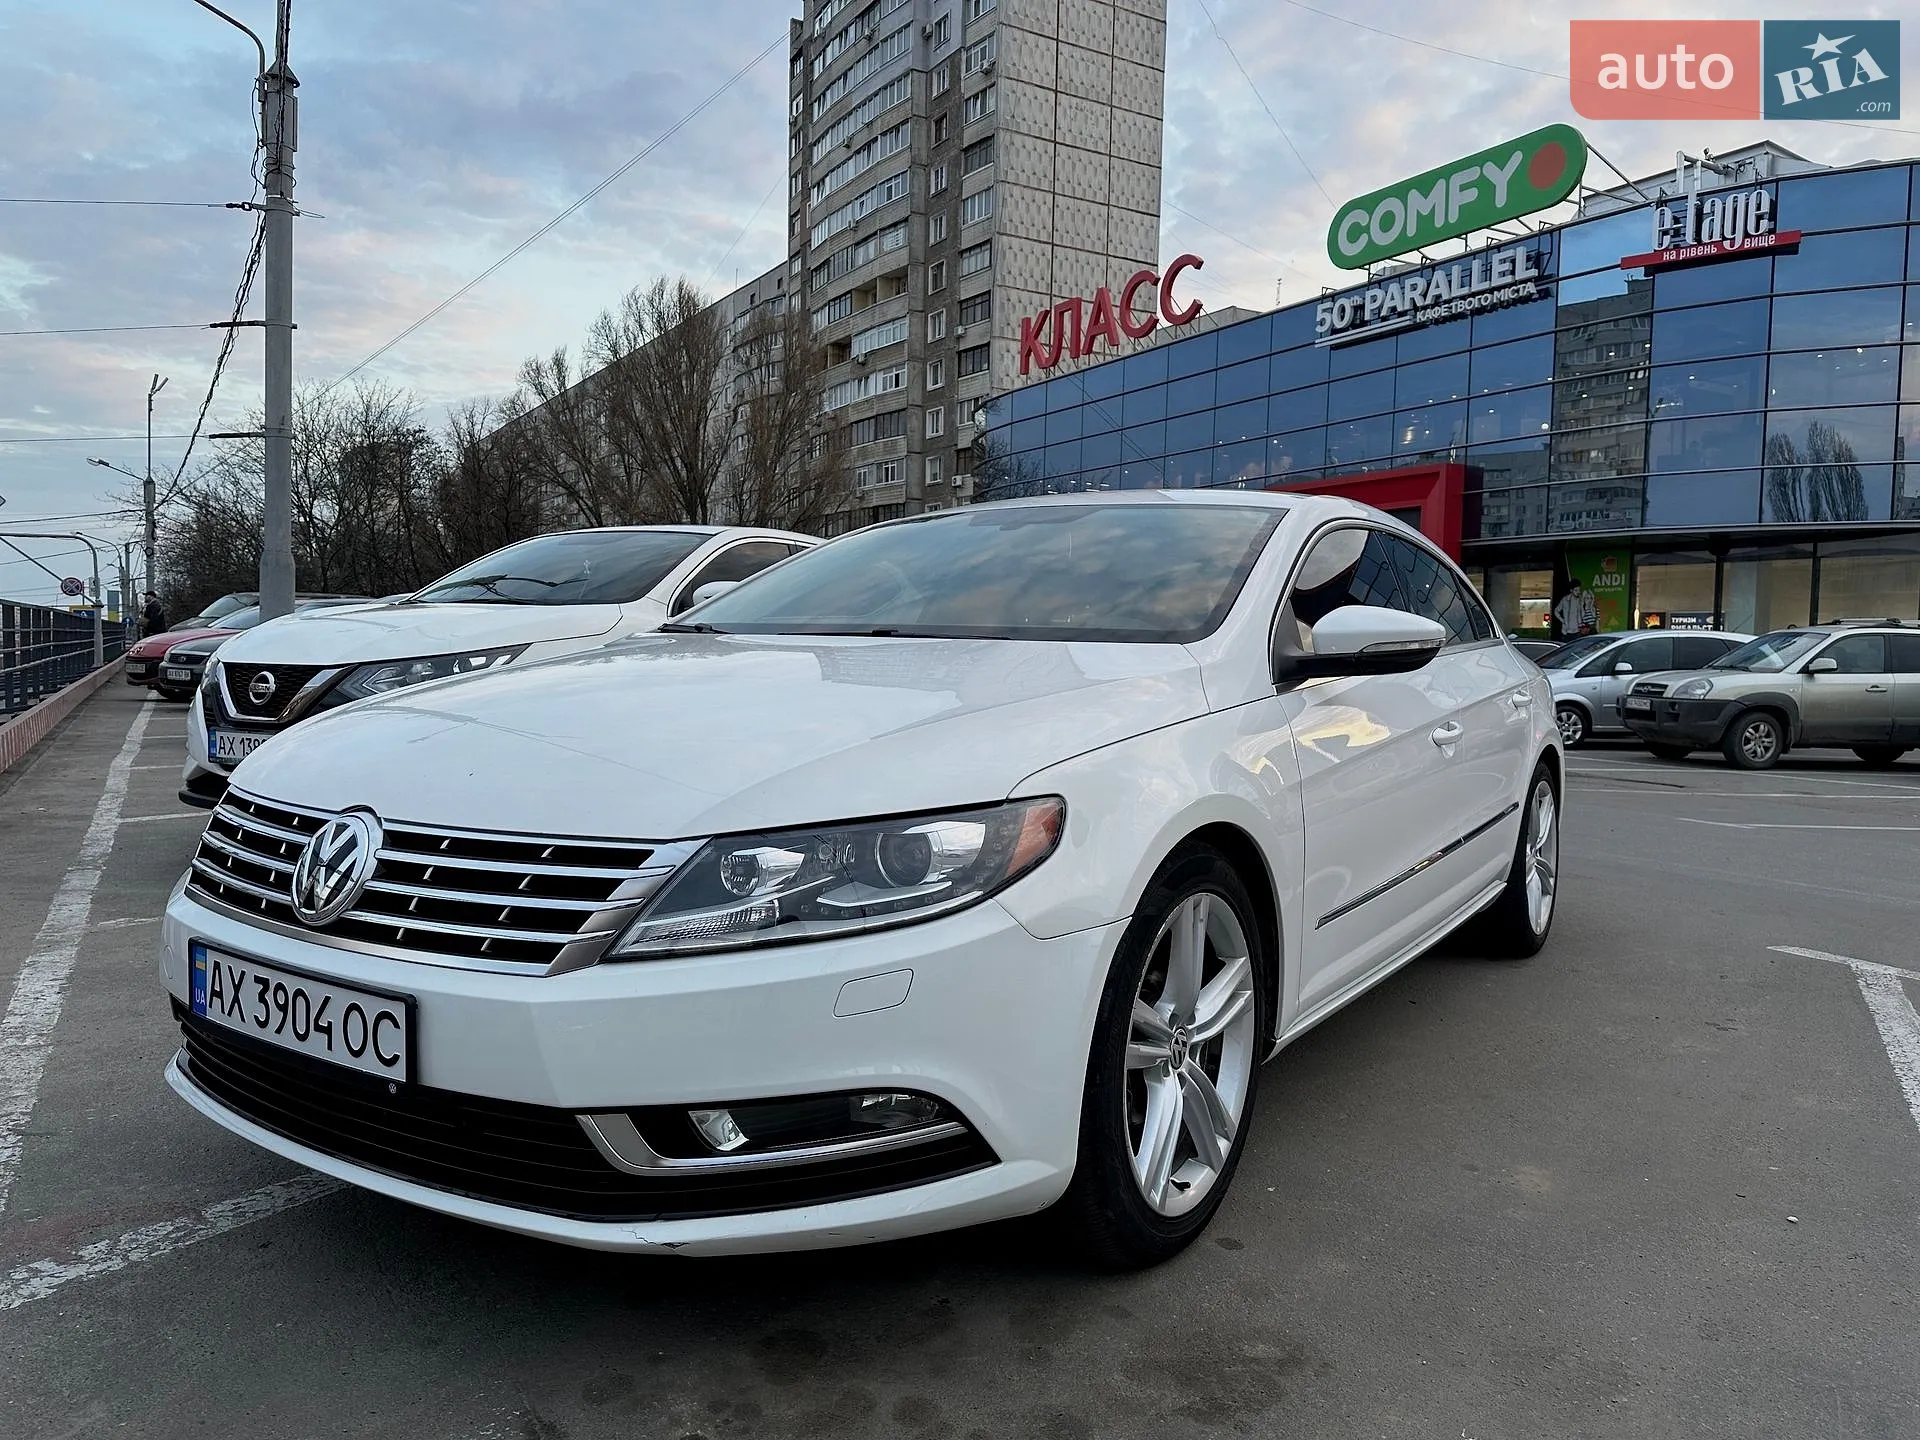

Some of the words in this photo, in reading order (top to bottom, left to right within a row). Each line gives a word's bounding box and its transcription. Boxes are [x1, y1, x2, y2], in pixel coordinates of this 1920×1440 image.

[1337, 150, 1523, 256] COMFY
[1663, 249, 1676, 261] на
[1680, 244, 1717, 261] рівень
[1744, 233, 1776, 249] вище
[1364, 246, 1538, 321] PARALLEL
[1416, 304, 1449, 323] КАФЕ
[1450, 293, 1493, 314] ТВОГО
[1493, 281, 1537, 303] МІСТА
[1019, 253, 1204, 375] КЛАСС
[1592, 573, 1625, 587] ANDI
[218, 735, 236, 756] AX
[195, 987, 206, 1006] UA
[208, 960, 246, 1023] AX
[253, 974, 333, 1052] 3904
[343, 1002, 401, 1067] OC
